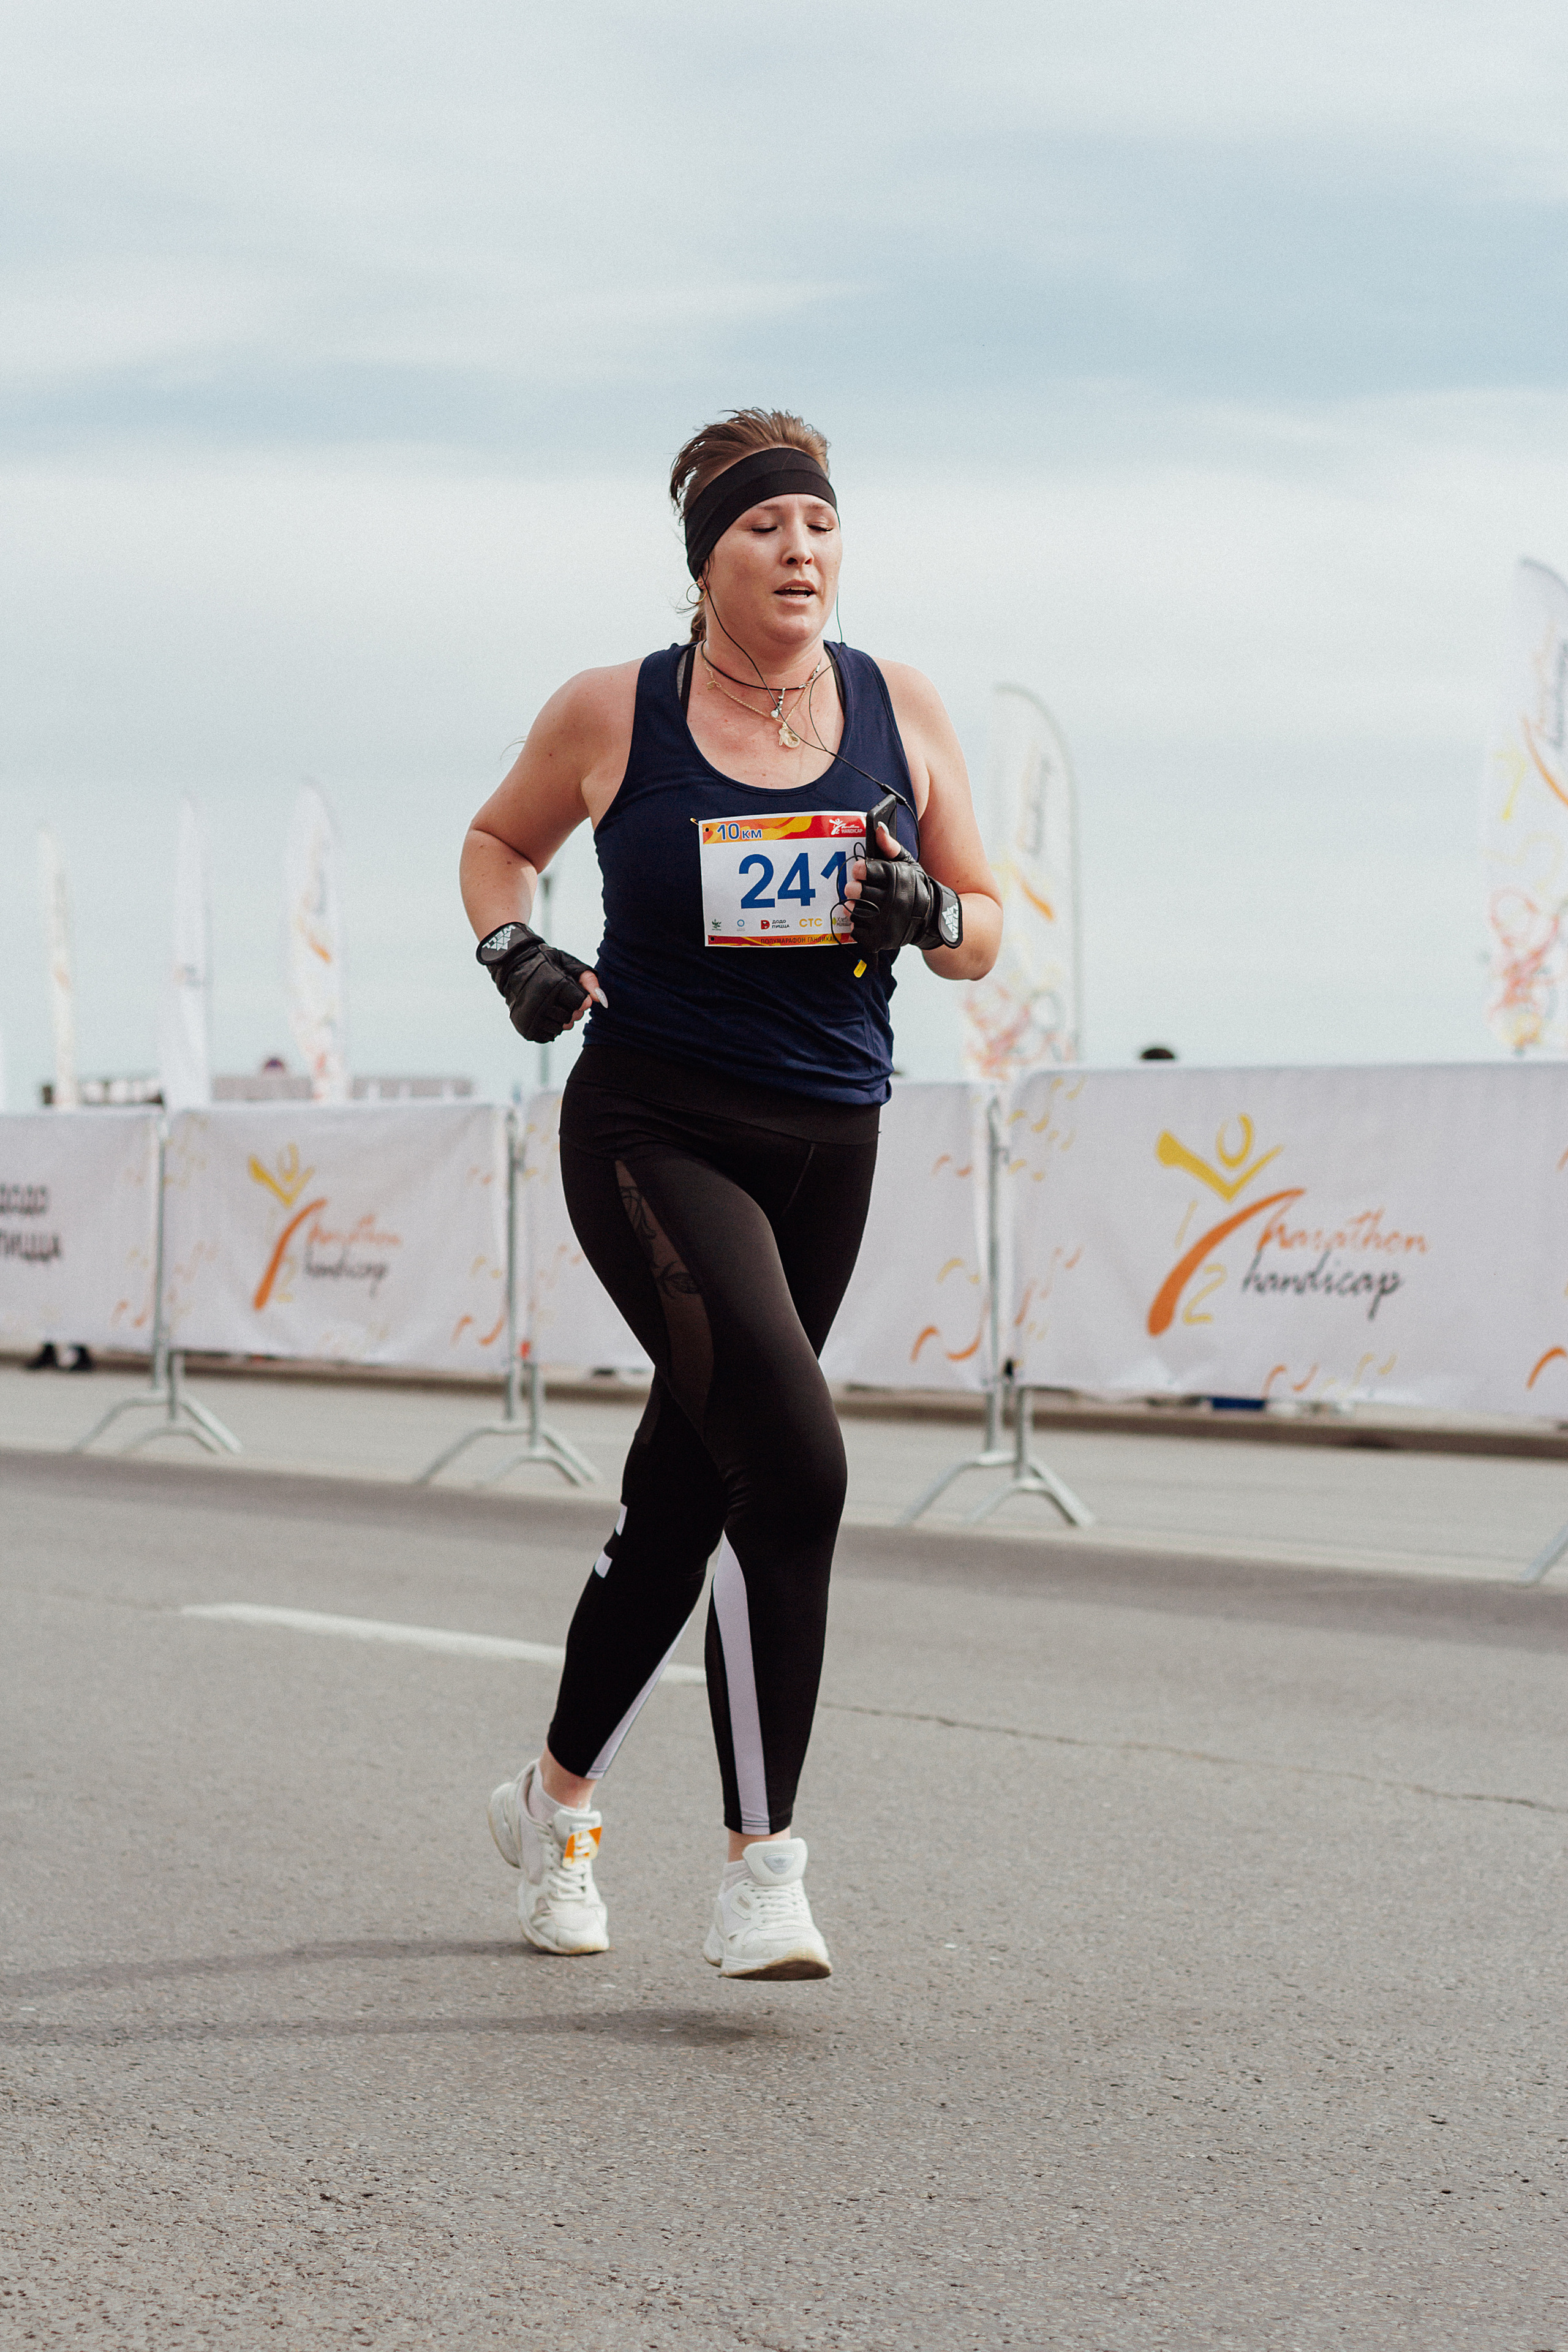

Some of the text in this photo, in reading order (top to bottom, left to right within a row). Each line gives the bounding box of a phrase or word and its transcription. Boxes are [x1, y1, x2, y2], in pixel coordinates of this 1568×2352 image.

[717, 823, 740, 840] 10
[739, 851, 848, 909] 241
[799, 918, 823, 927] СТС
[481, 925, 516, 949] WELL
[1242, 1248, 1404, 1321] handicap
